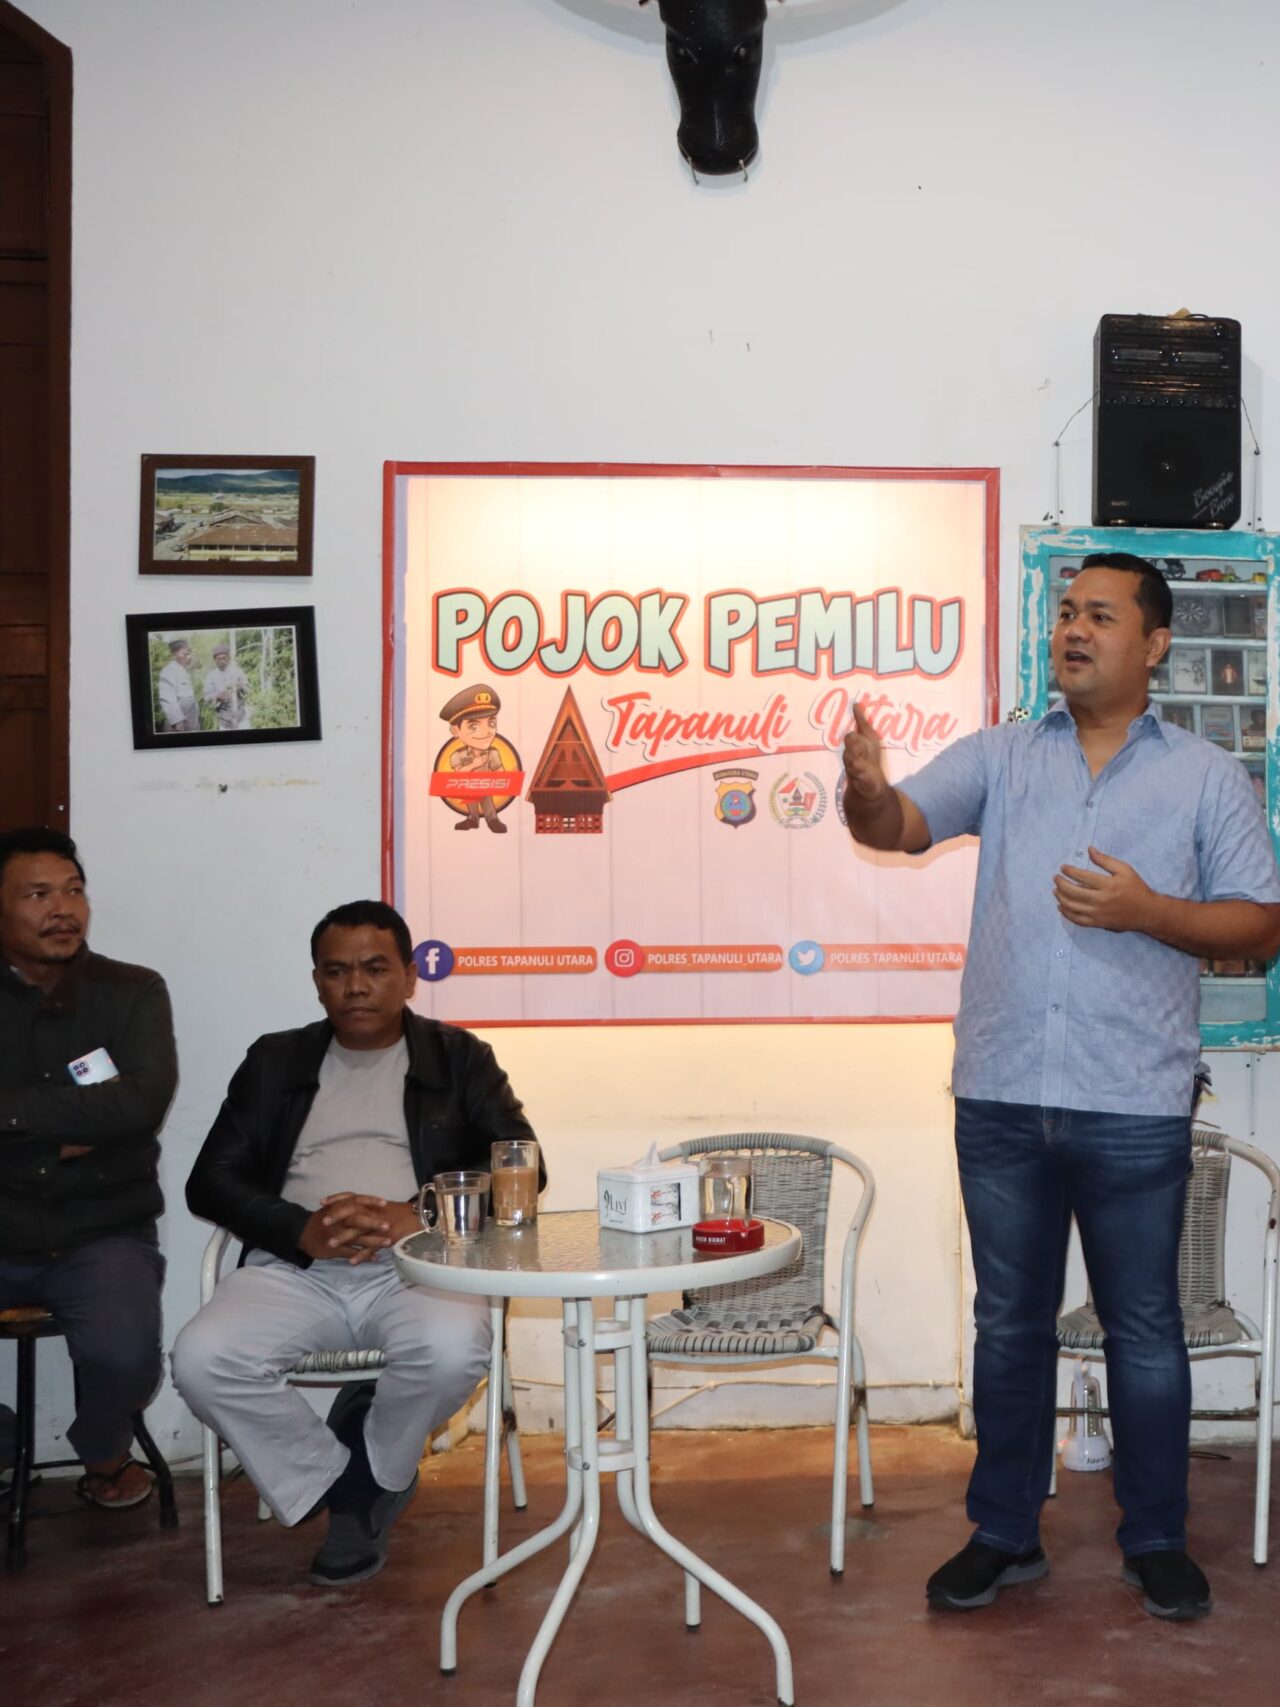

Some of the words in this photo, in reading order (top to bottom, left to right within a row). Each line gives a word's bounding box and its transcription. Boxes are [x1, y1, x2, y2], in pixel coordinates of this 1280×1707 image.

[432, 588, 688, 678] POJOK
[703, 587, 964, 678] PEMILU
[607, 691, 790, 757] Tapanuli
[812, 690, 957, 750] Utara
[446, 778, 511, 790] PRESISI
[458, 955, 498, 967] POLRES
[501, 954, 554, 966] TAPANULI
[557, 954, 593, 966] UTARA
[830, 952, 869, 963] POLRES
[874, 952, 924, 963] TAPANULI
[928, 951, 964, 963] UTARA
